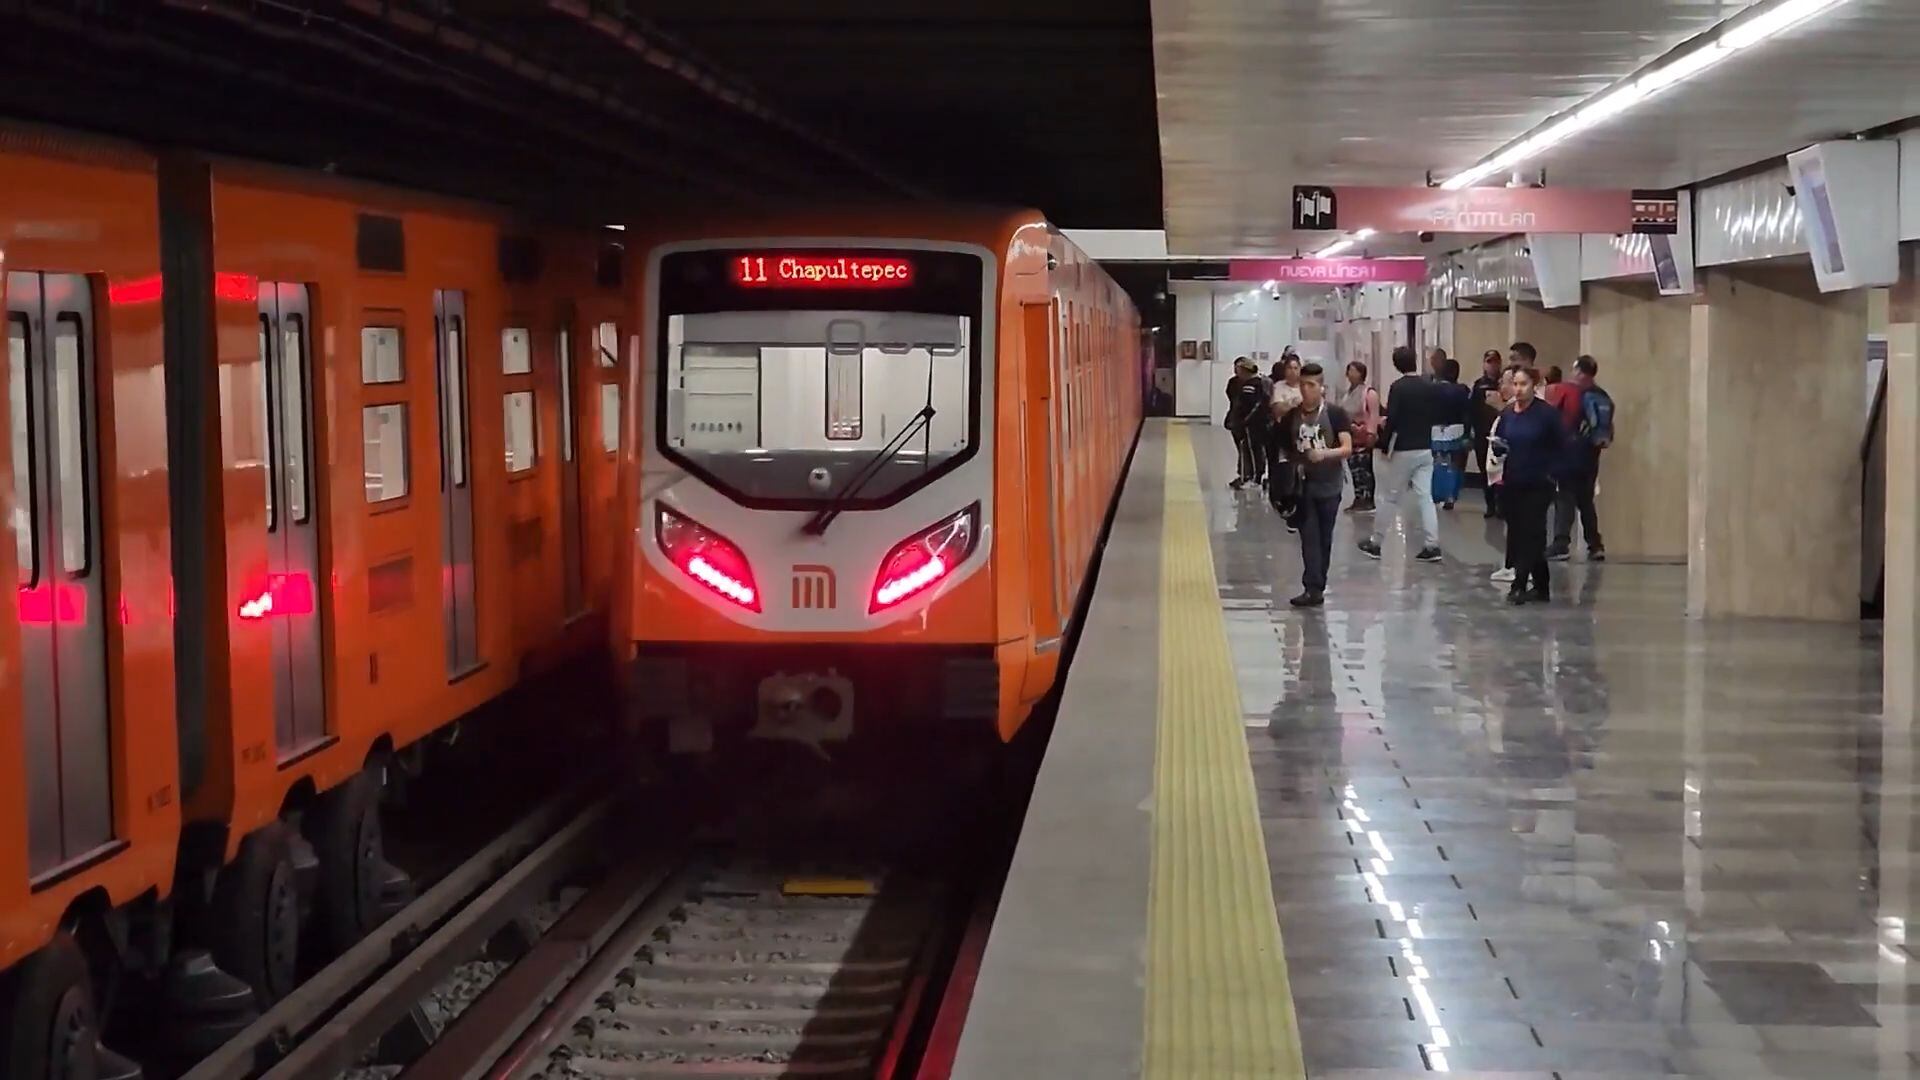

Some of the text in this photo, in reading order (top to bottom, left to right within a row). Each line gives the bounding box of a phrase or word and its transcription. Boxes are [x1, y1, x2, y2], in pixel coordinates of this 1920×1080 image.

[740, 257, 907, 282] 11 Chapultepec
[1281, 264, 1326, 277] NUEVA
